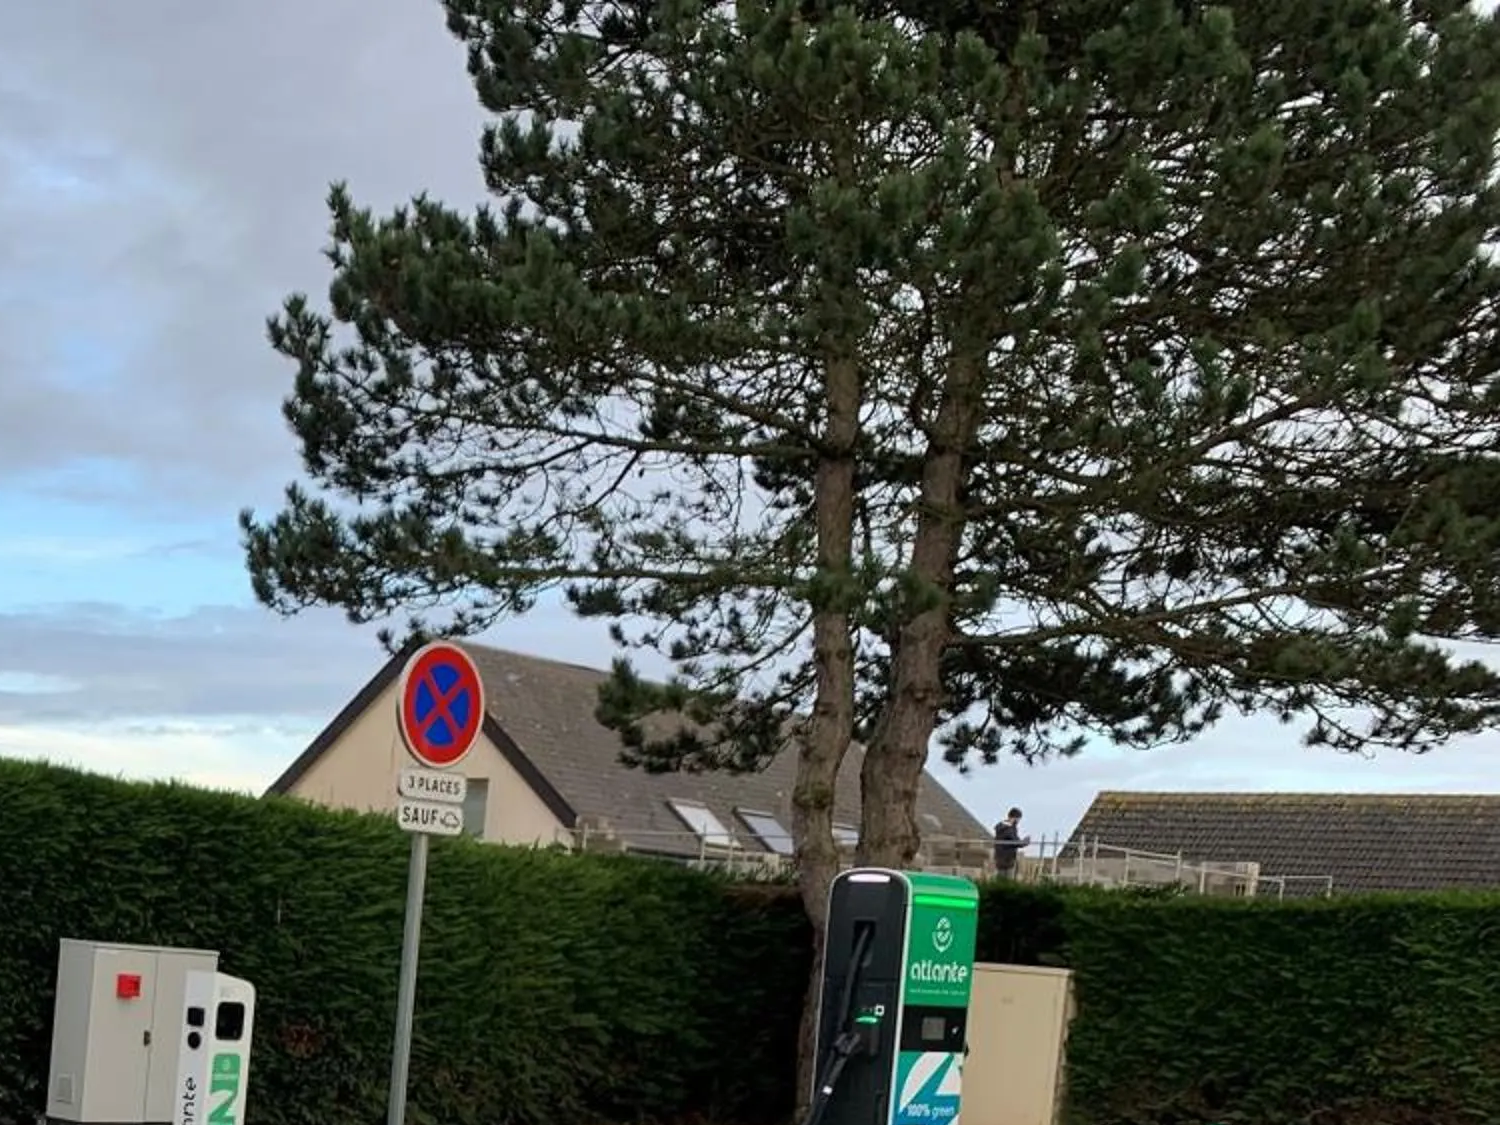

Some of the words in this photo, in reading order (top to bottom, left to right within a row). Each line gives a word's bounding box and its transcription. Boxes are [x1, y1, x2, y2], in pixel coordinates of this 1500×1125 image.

[407, 776, 416, 789] 3
[418, 776, 461, 795] PLACES
[402, 806, 439, 825] SAUF
[910, 959, 969, 983] atlante
